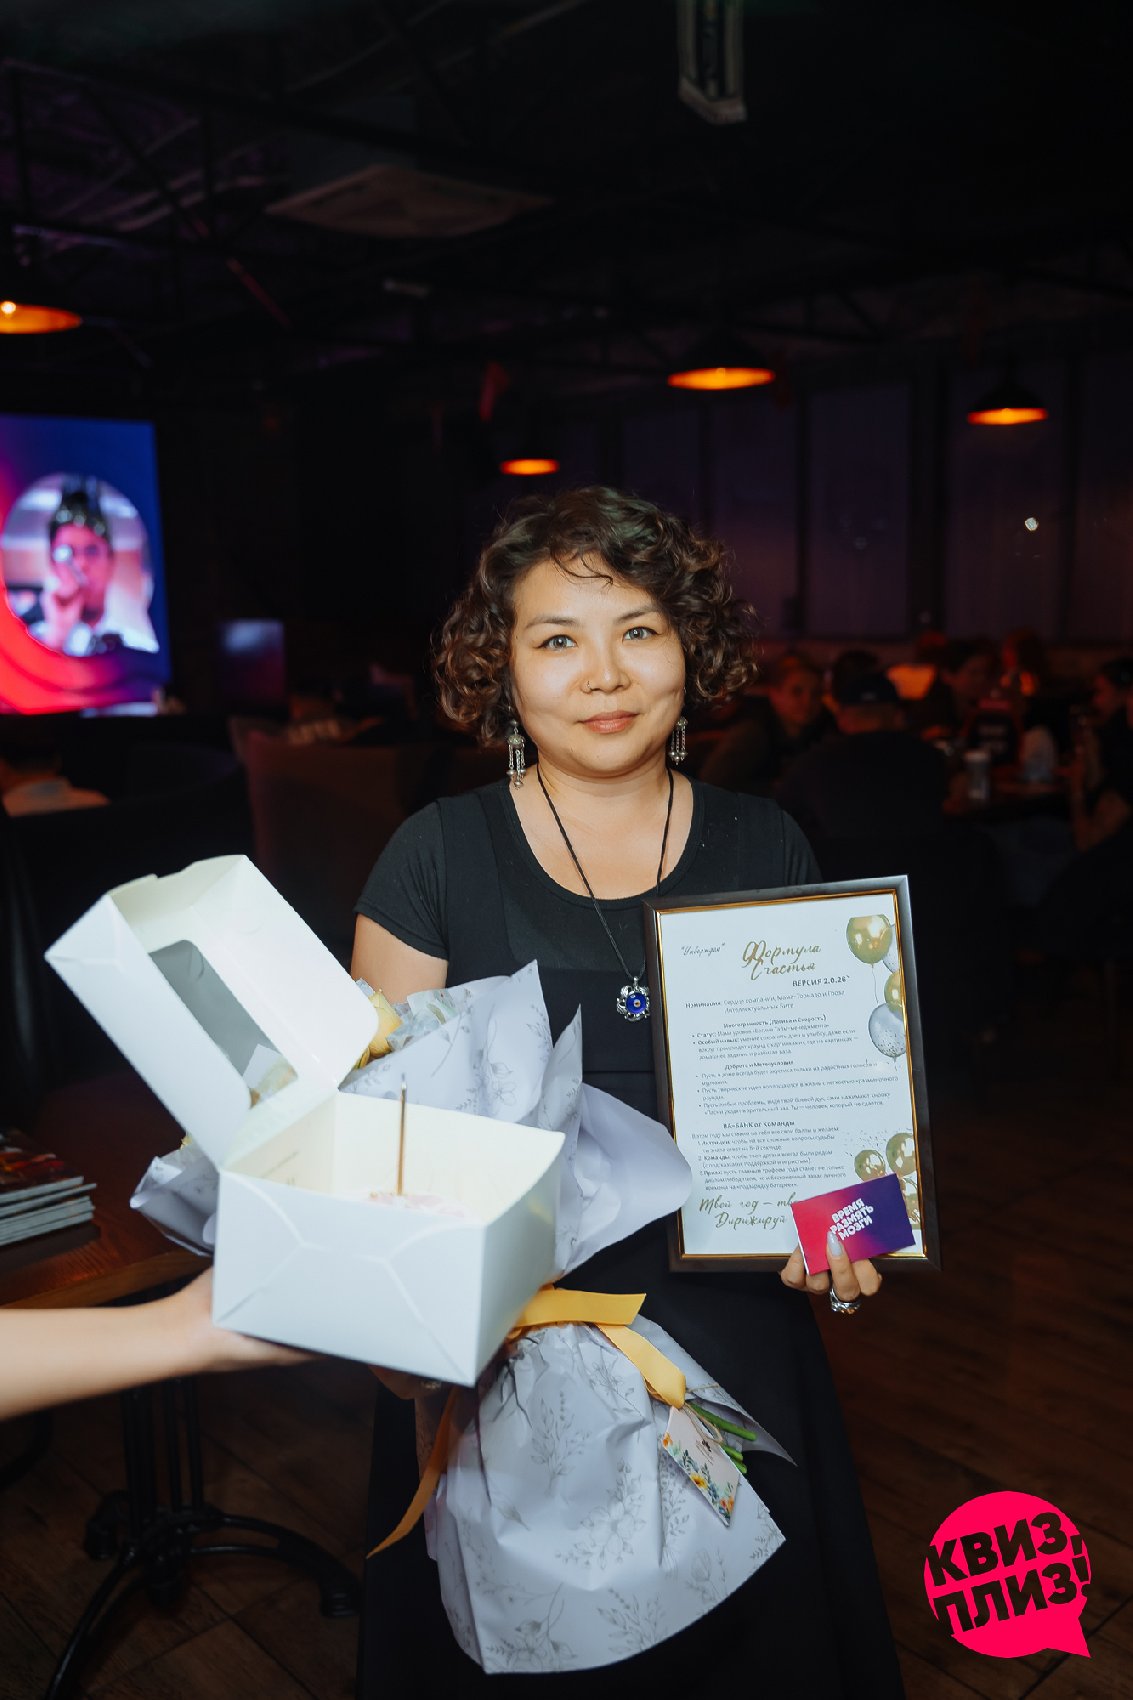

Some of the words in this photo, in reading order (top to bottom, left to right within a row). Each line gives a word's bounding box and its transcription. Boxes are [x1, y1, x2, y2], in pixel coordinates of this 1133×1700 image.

[830, 1205, 874, 1235] РАЗМЯТЬ
[832, 1198, 864, 1223] ВРЕМЯ
[838, 1215, 873, 1240] МОЗГИ
